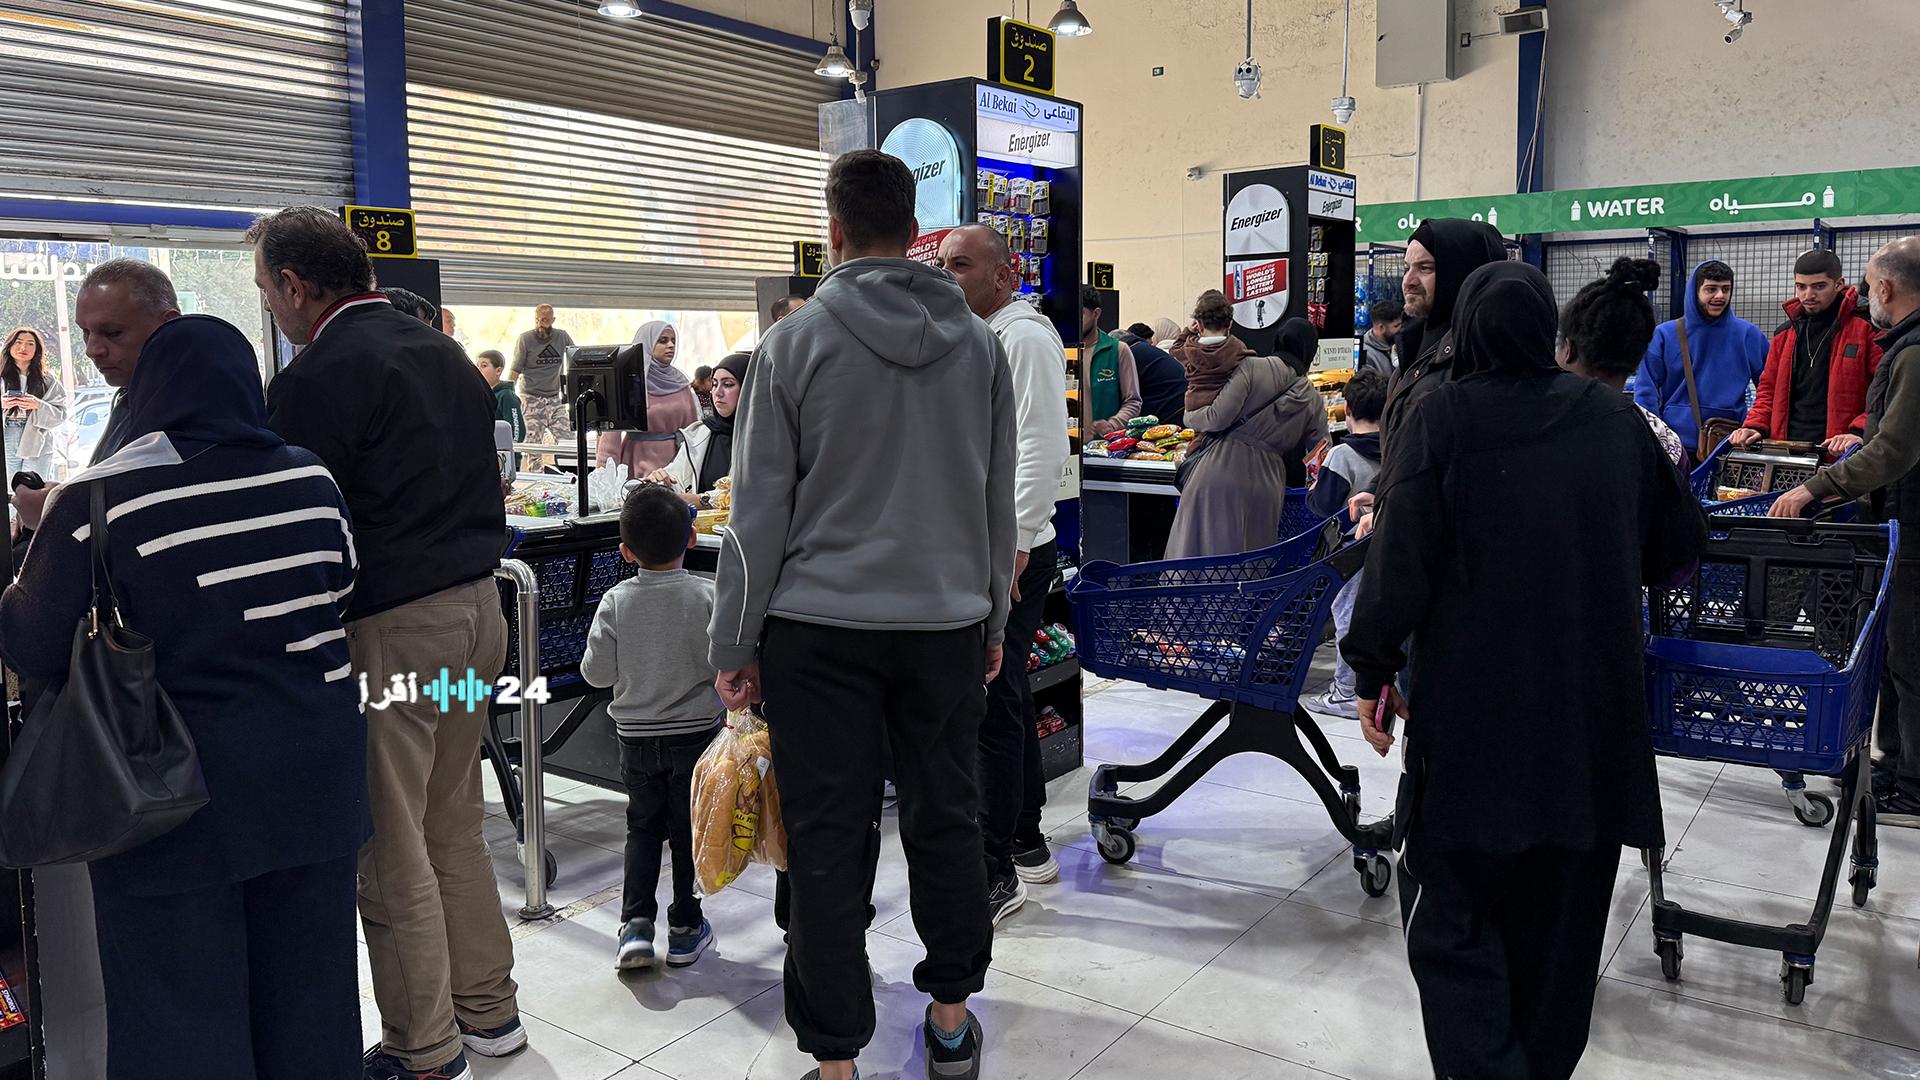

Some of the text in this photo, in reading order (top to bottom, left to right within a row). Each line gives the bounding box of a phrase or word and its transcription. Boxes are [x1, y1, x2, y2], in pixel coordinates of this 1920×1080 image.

[1011, 26, 1047, 51] صندوق
[1023, 54, 1035, 82] 2
[980, 92, 1017, 114] Al Bekai
[1008, 131, 1051, 154] Energizer
[1331, 147, 1337, 165] 3
[911, 159, 945, 184] gizer
[1587, 197, 1665, 218] WATER
[1709, 192, 1816, 215] مياه
[358, 211, 405, 228] صندوق
[1230, 207, 1283, 231] Energizer
[376, 230, 392, 251] 8
[815, 257, 823, 273] 7
[1246, 267, 1275, 280] WORLD'S
[1101, 274, 1107, 286] 6
[1246, 273, 1275, 286] LONGEST
[1246, 279, 1275, 292] BATTERY
[1246, 284, 1274, 297] LASTING
